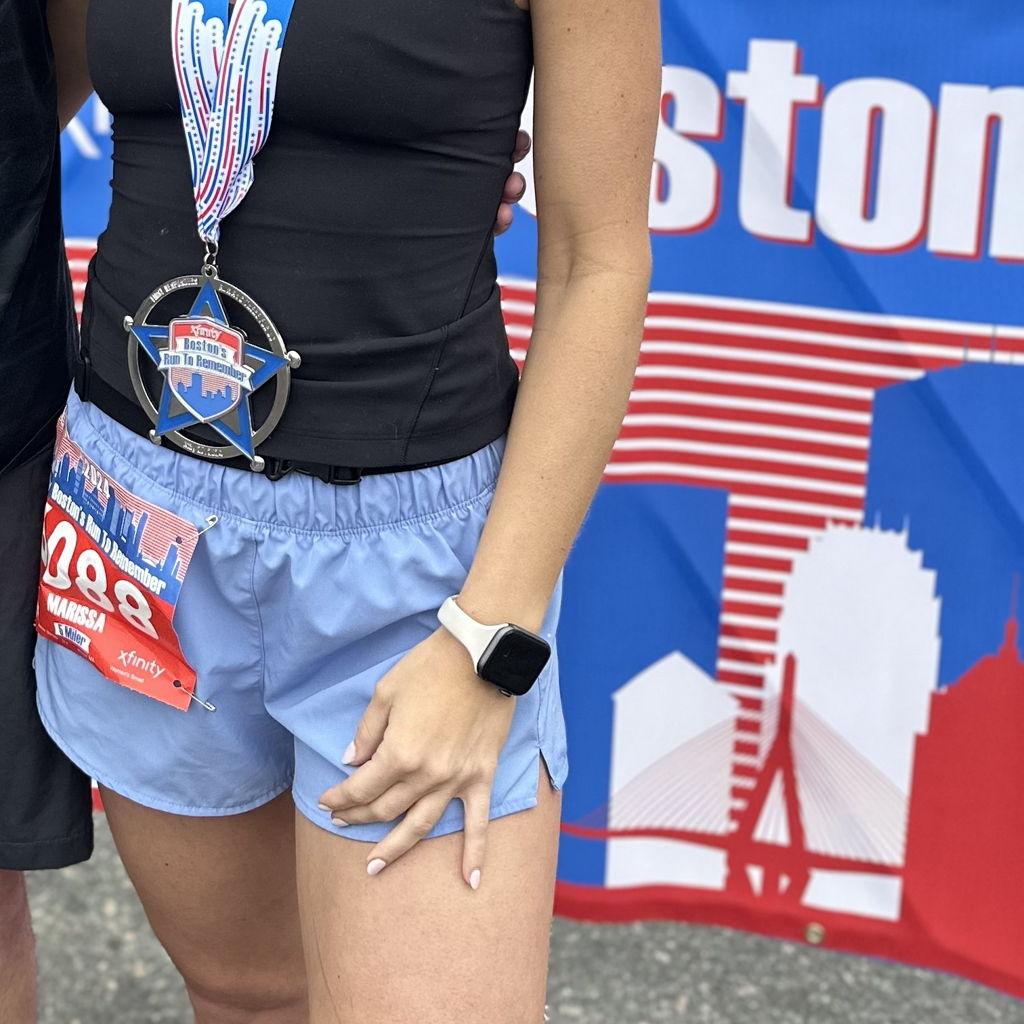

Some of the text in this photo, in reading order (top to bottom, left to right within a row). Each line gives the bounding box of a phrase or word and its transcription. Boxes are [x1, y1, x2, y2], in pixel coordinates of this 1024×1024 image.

[184, 338, 227, 358] Boston's
[164, 353, 247, 382] Run To Remember
[83, 461, 111, 498] 2024
[51, 482, 167, 595] Boston's Run To Remember
[47, 592, 106, 634] MARISSA
[58, 624, 64, 636] 5
[65, 626, 86, 646] Miler
[118, 650, 166, 678] xfinity
